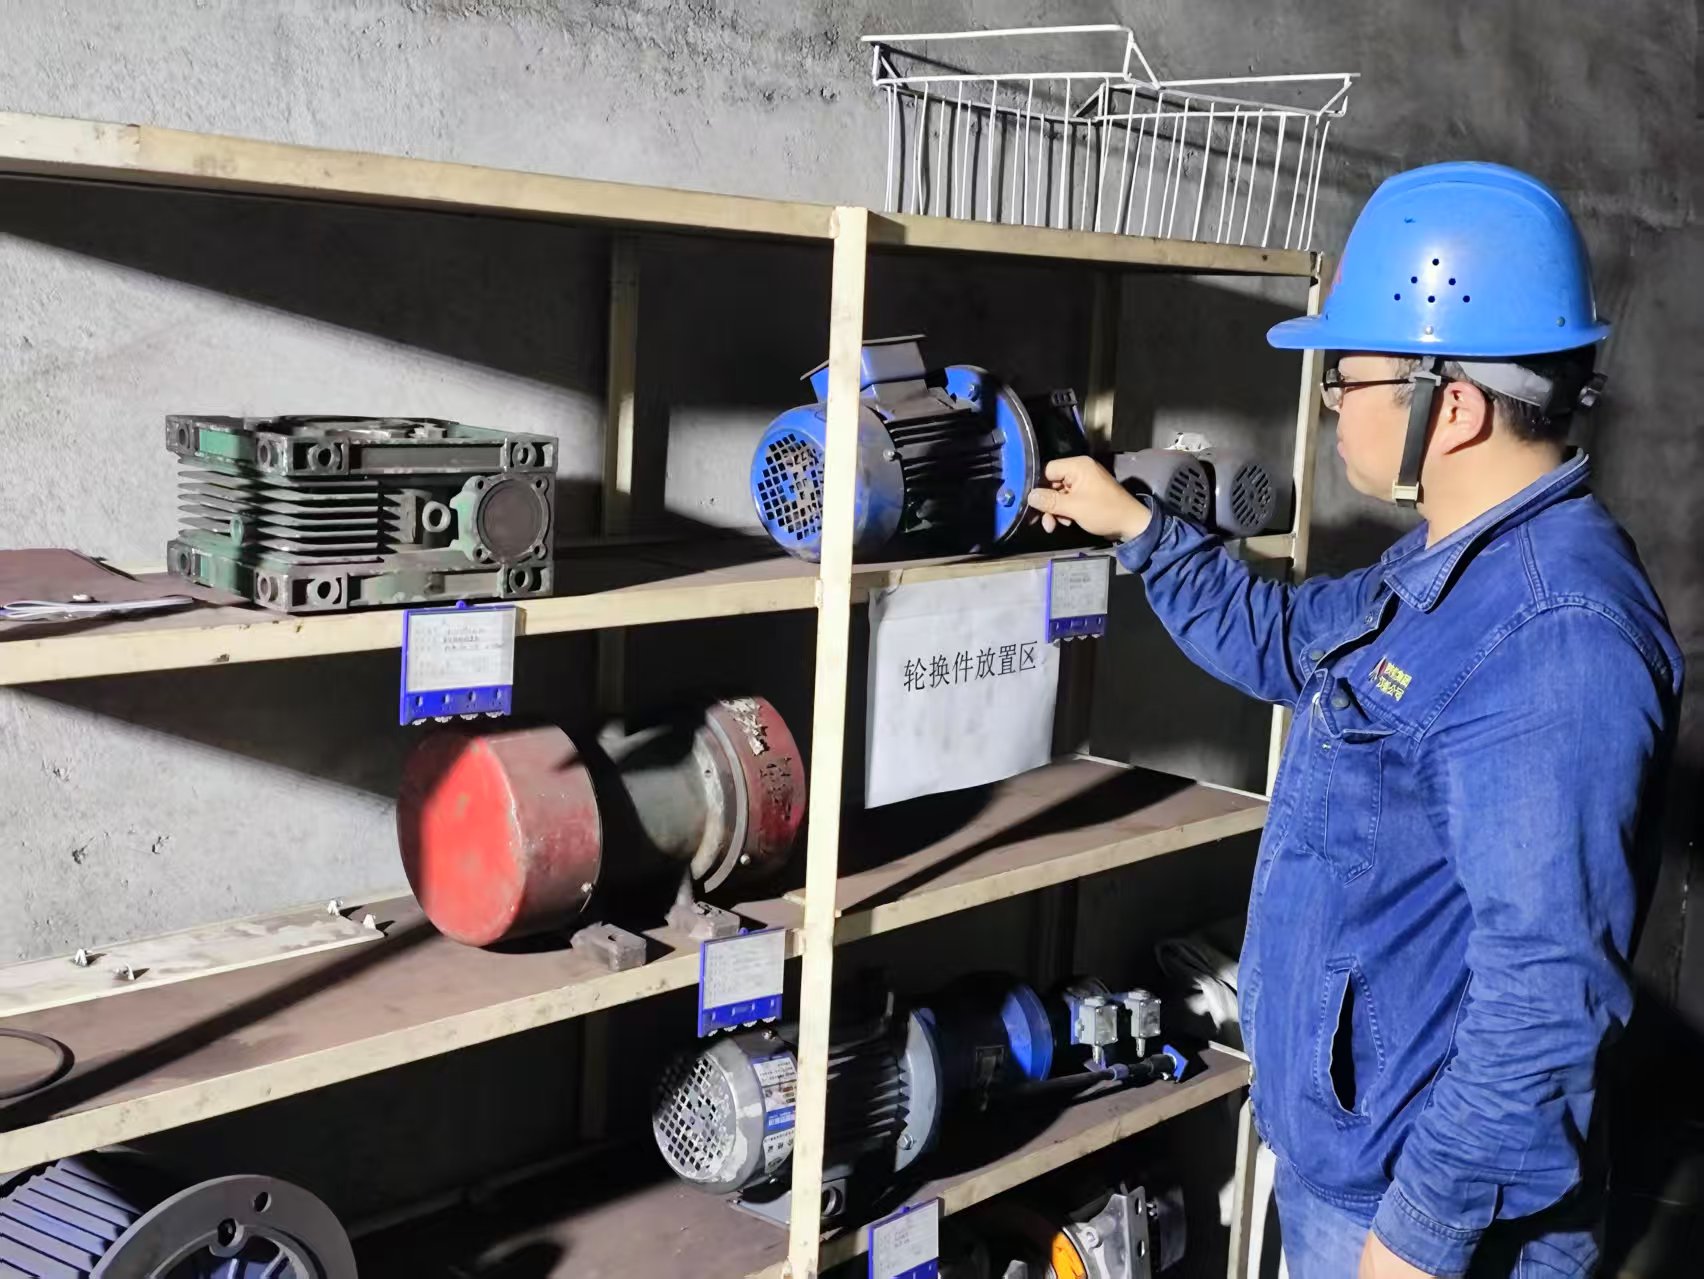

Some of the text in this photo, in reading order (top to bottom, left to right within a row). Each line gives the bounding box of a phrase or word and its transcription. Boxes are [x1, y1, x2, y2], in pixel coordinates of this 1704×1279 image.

[903, 640, 1038, 692] 轮换件放置区
